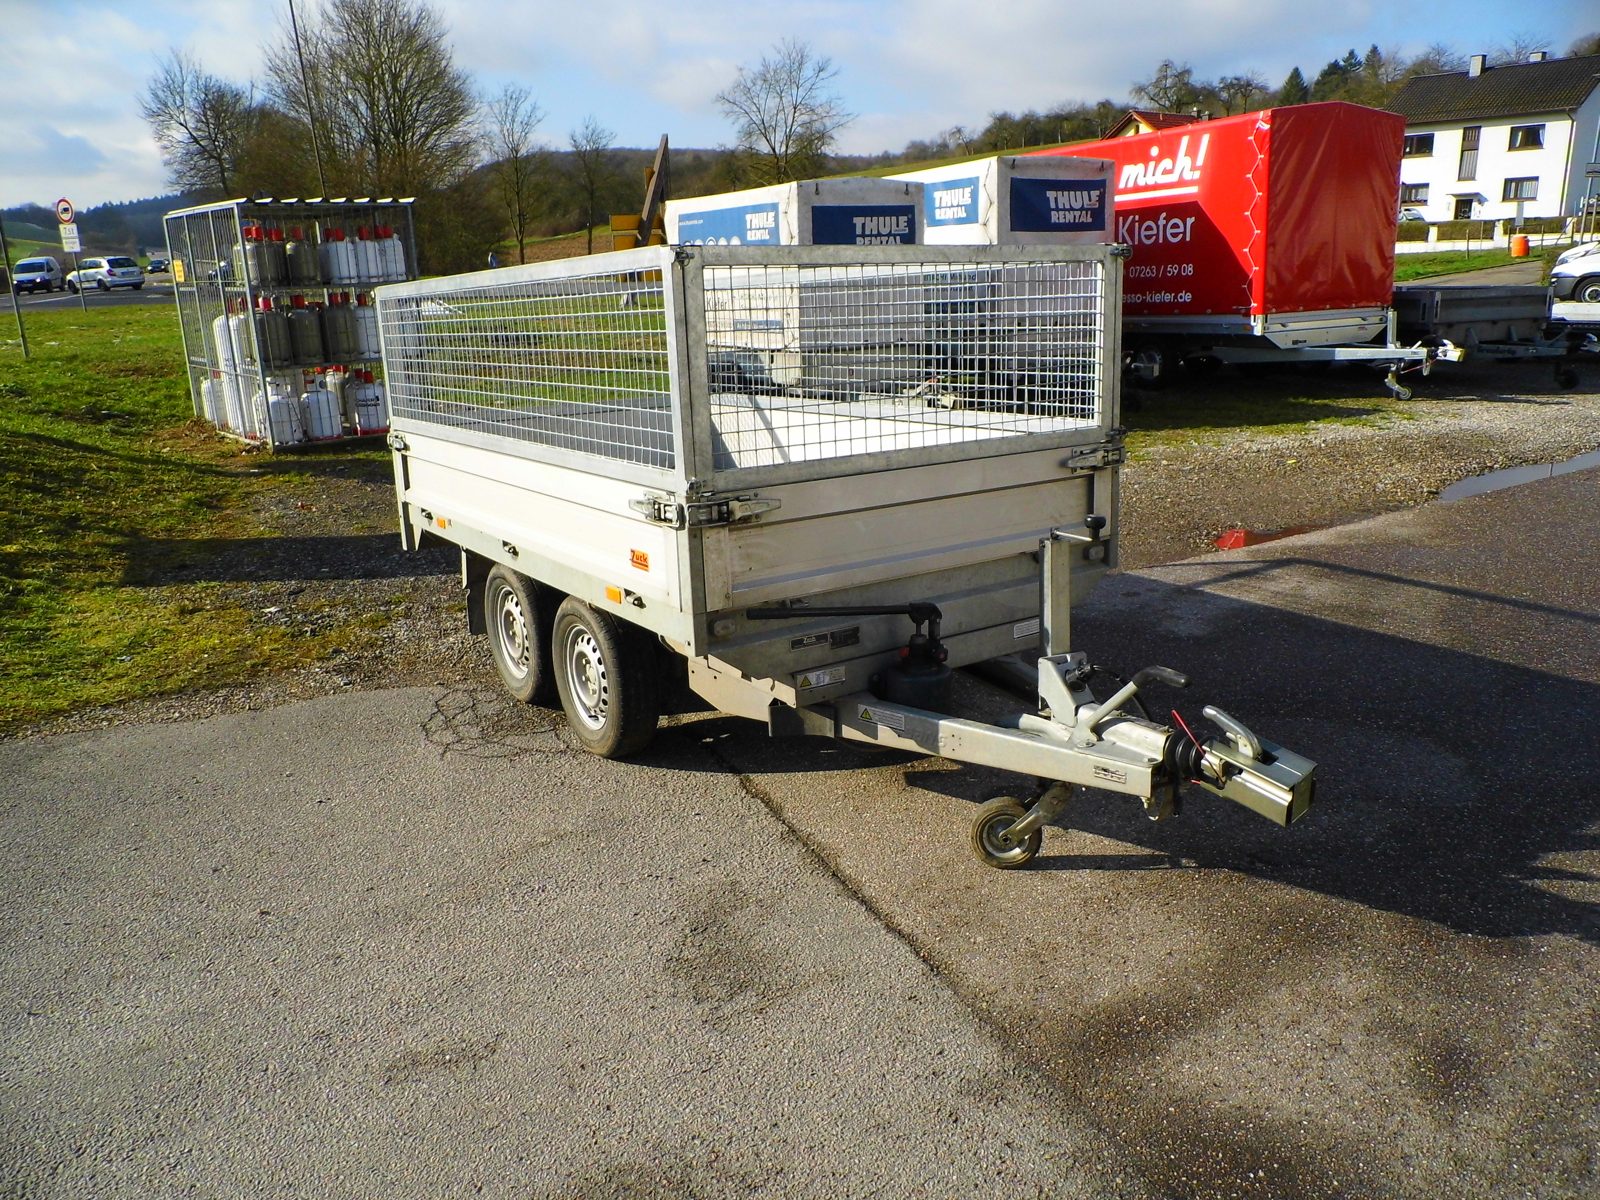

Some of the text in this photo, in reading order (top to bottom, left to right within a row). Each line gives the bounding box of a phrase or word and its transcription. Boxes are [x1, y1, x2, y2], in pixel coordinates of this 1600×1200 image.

[1118, 133, 1210, 189] mich!
[933, 187, 972, 208] THULE
[1046, 190, 1100, 209] THULE
[745, 211, 776, 230] THULE
[852, 215, 909, 235] THULE
[1051, 210, 1093, 223] RENTAL
[1118, 212, 1196, 245] Kiefer
[1129, 263, 1194, 278] 07263 / 59 08
